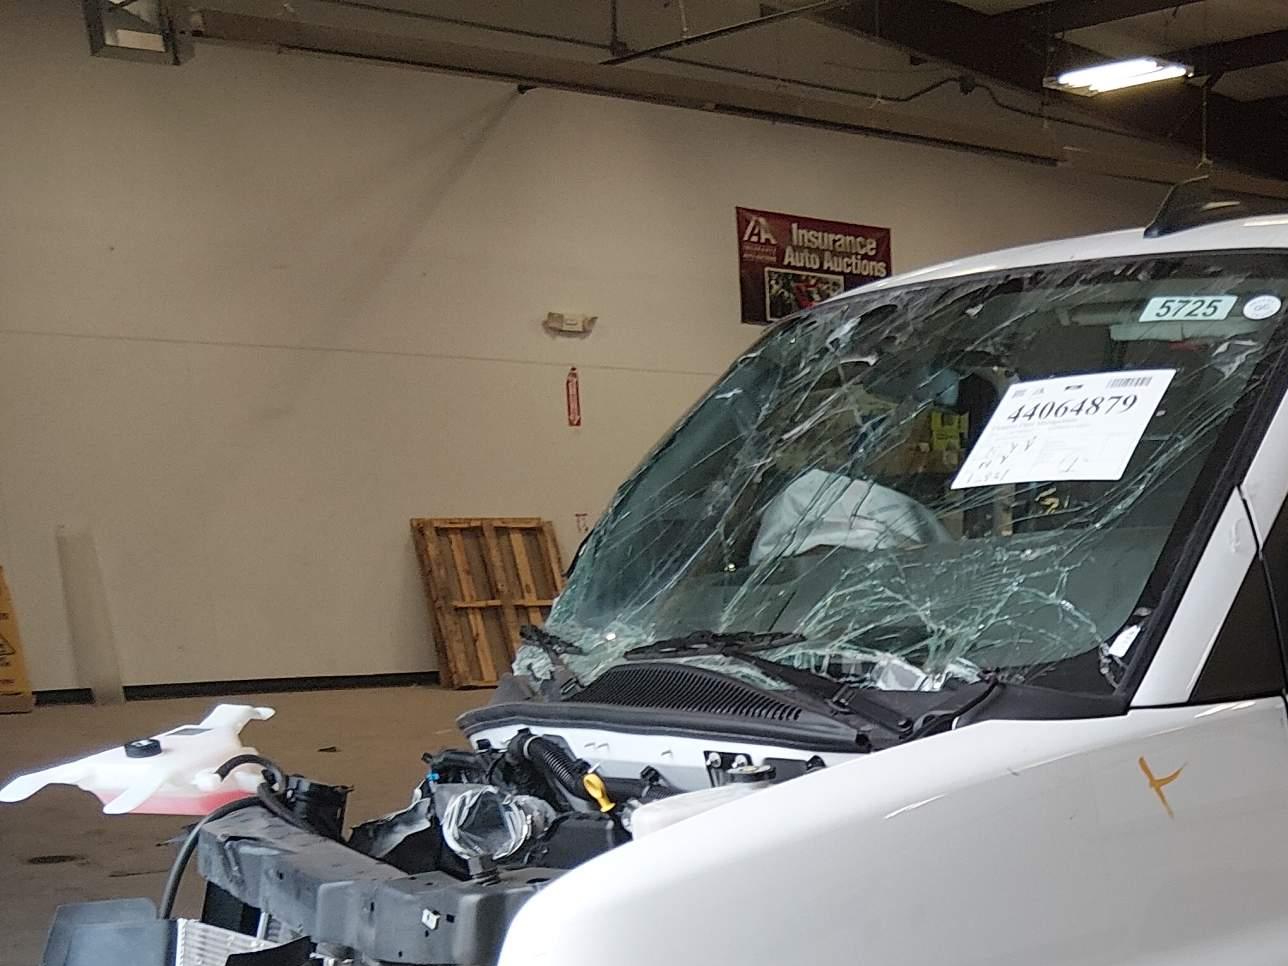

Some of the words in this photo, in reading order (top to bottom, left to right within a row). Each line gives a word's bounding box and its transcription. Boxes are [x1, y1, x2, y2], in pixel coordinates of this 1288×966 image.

[791, 222, 877, 256] Insurance
[783, 246, 820, 269] Auto
[823, 251, 887, 278] Auctions
[1155, 299, 1222, 318] 5725
[1007, 394, 1138, 423] 44064879
